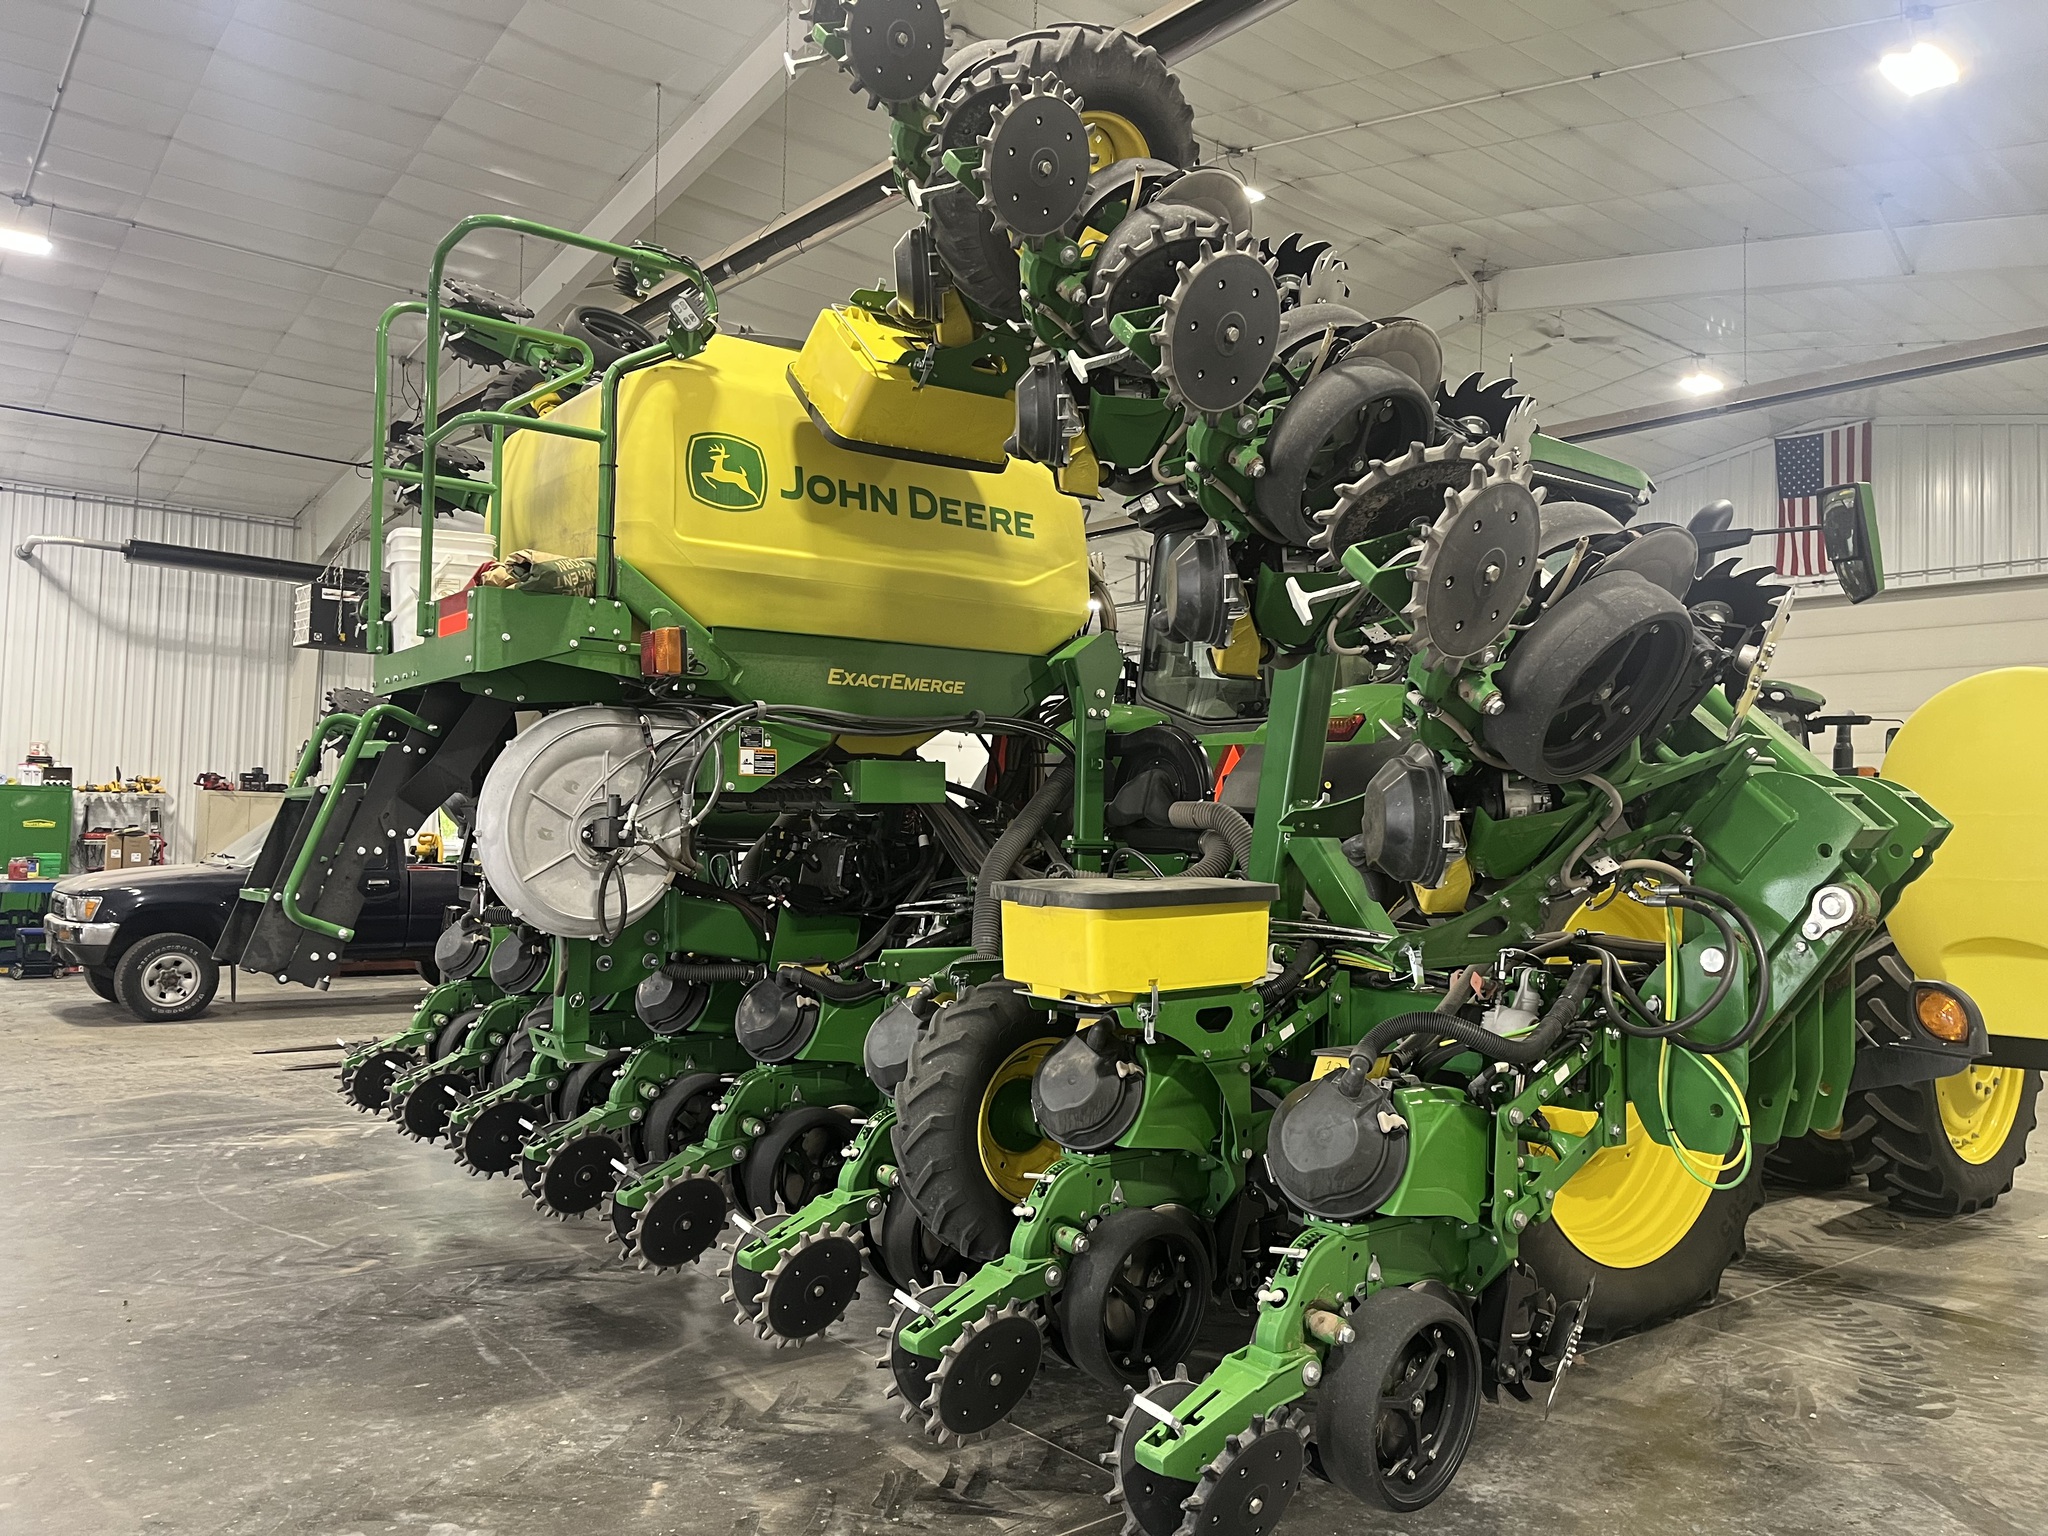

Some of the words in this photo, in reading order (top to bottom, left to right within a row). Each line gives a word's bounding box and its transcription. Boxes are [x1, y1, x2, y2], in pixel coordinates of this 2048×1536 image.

[781, 466, 898, 515] JOHN
[908, 486, 1035, 539] DEERE
[827, 668, 966, 695] EXACTEMERGE
